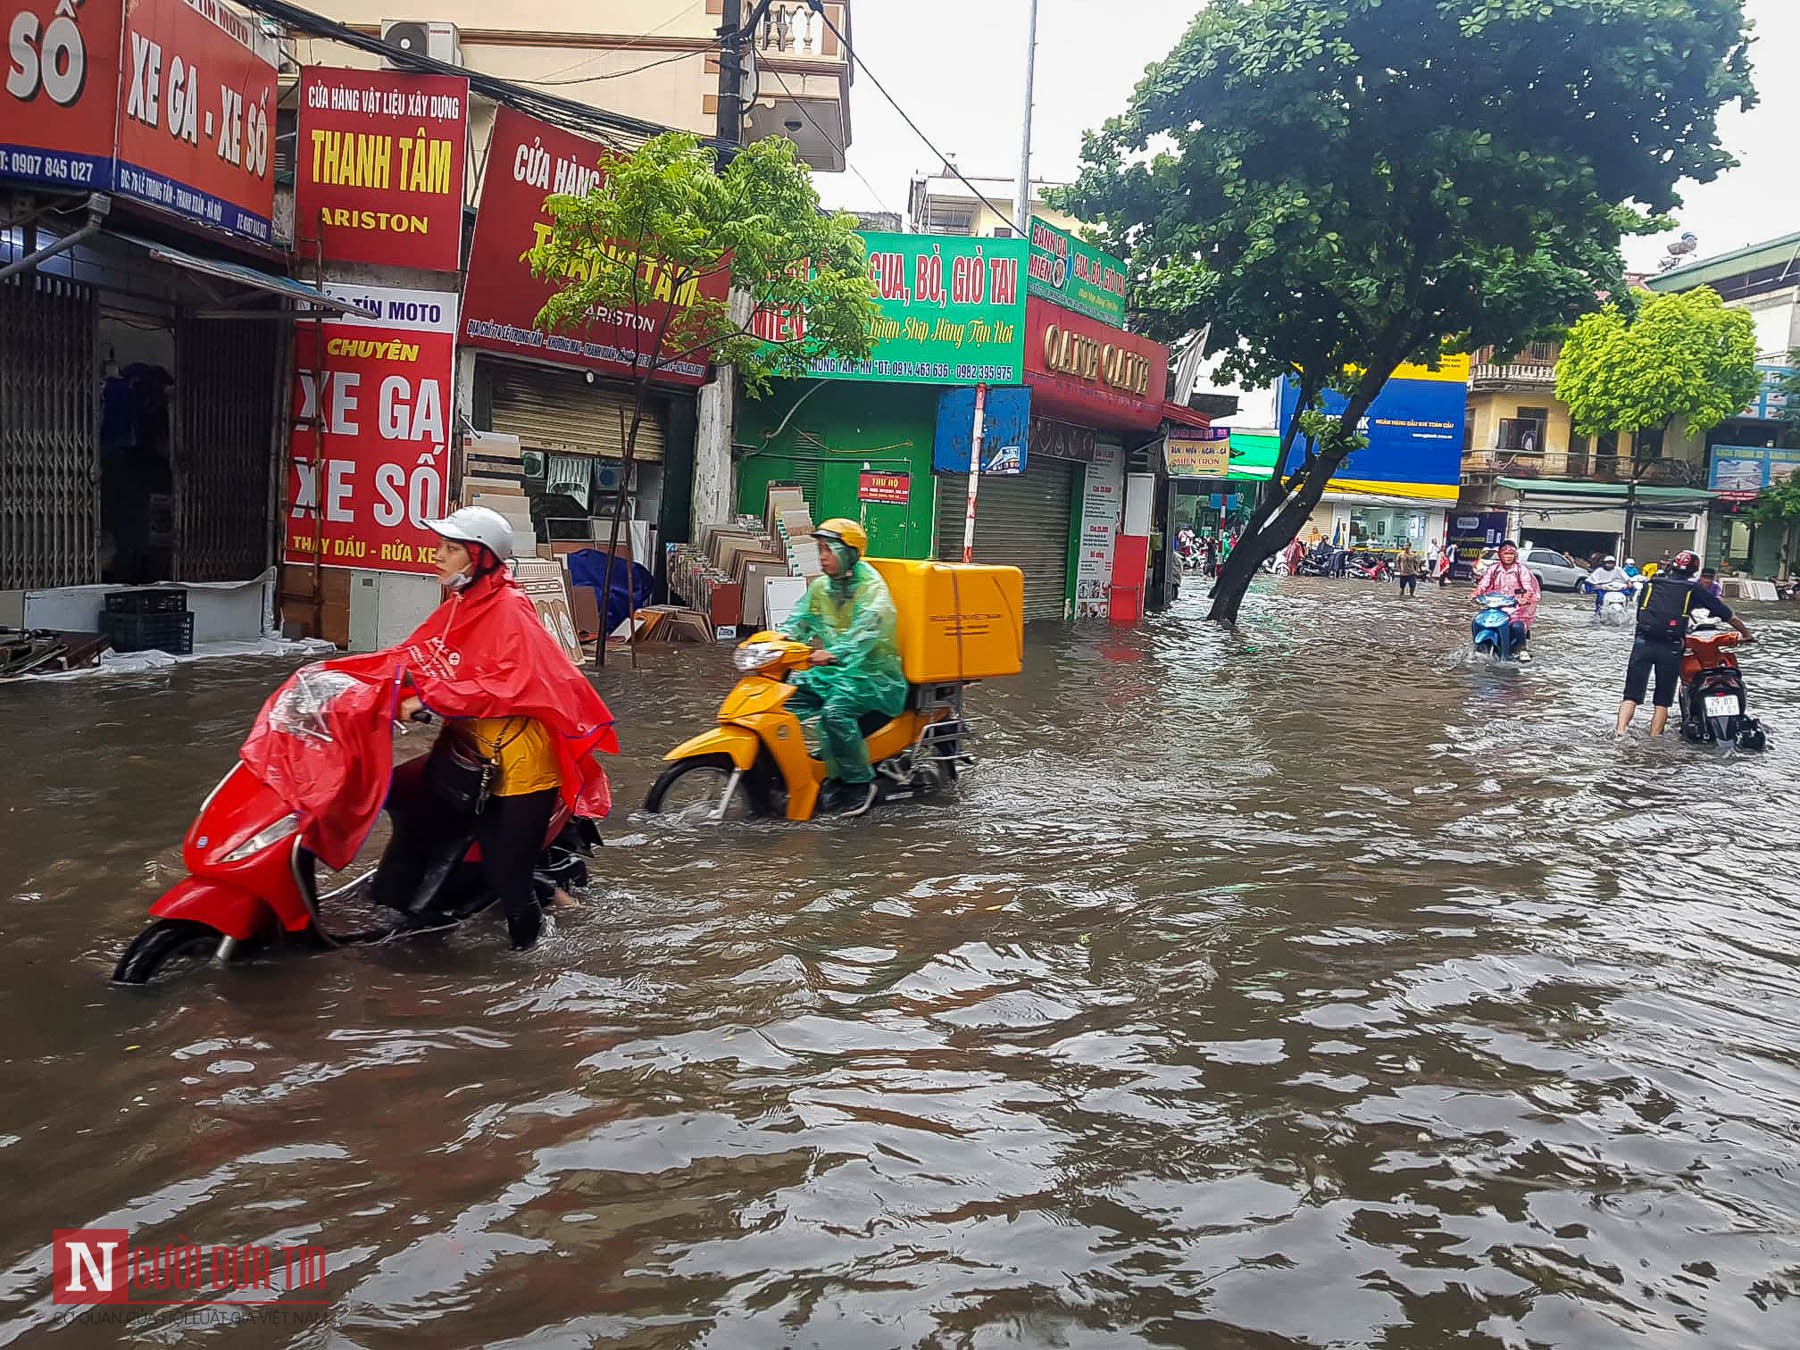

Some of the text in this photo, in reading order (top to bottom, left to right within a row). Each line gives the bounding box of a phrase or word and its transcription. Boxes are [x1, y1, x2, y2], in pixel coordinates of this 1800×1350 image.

[127, 31, 162, 126] XE
[167, 56, 198, 145] GA
[217, 84, 242, 165] XE
[248, 86, 268, 178] SỐ
[308, 79, 460, 123] CỬA HÀNG VẬT LIỆU XÂY DỰNG
[12, 153, 42, 175] 0907
[45, 157, 67, 178] 845
[70, 160, 94, 182] 027
[311, 126, 452, 194] THANH TÂM
[513, 136, 551, 190] CỬA
[321, 206, 429, 235] ARISTON
[1031, 222, 1057, 254] BÁNH
[915, 243, 947, 309] BÒ,
[952, 245, 985, 304] GIÒ
[989, 258, 1018, 305] TAI
[1028, 252, 1053, 282] MIẾN
[388, 301, 442, 324] MOTO
[902, 316, 930, 344] Ship
[931, 317, 965, 349] Hàng
[966, 315, 991, 348] Tận
[326, 337, 420, 362] CHUYÊN
[892, 361, 913, 376] 0914
[914, 363, 931, 377] 463
[932, 363, 949, 377] 636
[956, 364, 977, 379] 0982
[979, 365, 995, 379] 395
[996, 366, 1013, 380] 975
[295, 368, 445, 443] XE GA
[291, 444, 445, 531] XE SỐ
[334, 535, 366, 558] DẦU
[381, 538, 413, 562] RỬA
[417, 546, 437, 563] XE
